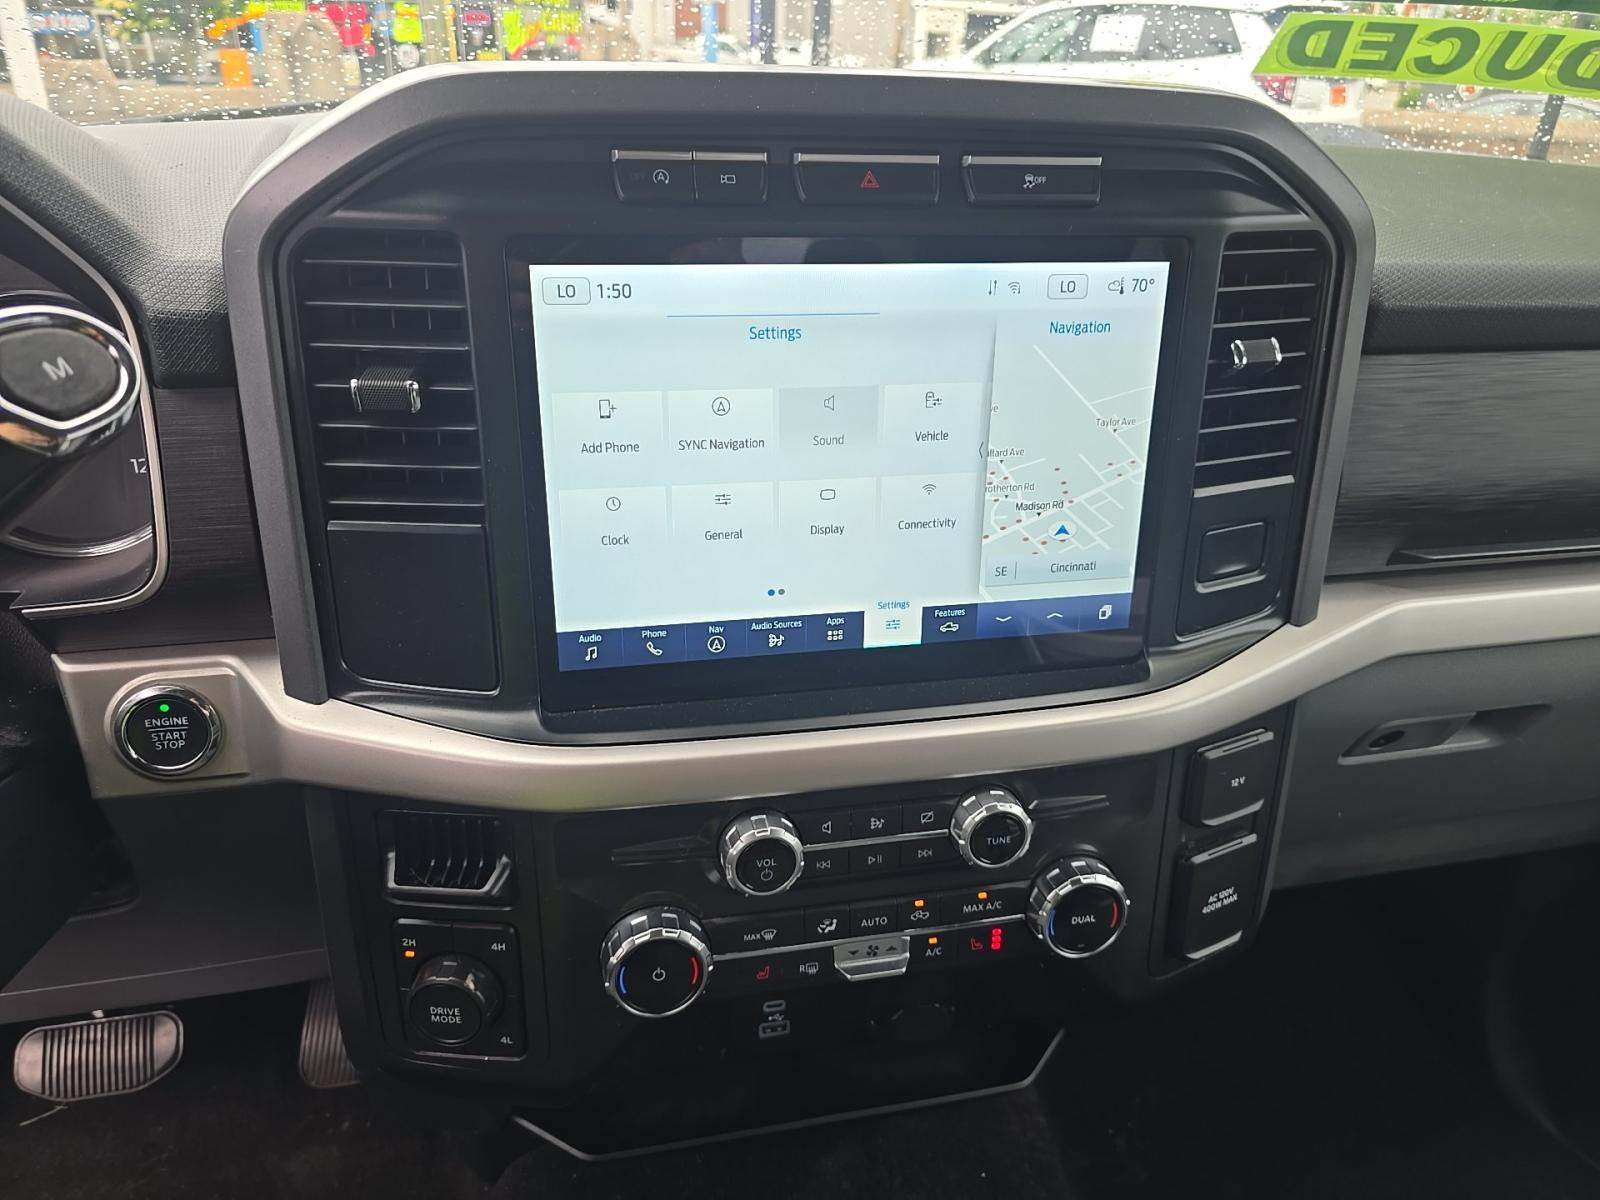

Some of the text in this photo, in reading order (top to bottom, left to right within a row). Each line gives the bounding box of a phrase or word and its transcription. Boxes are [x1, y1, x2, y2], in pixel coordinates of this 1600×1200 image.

[1034, 176, 1047, 184] OFF
[556, 283, 576, 299] LO
[595, 283, 632, 299] 1:50
[1060, 279, 1076, 294] LO
[1132, 277, 1155, 293] 70°
[749, 326, 801, 341] Settings
[1049, 320, 1111, 336] Navigation
[41, 356, 74, 381] M
[1096, 416, 1137, 429] Taylor Ave
[813, 434, 844, 447] Sound
[915, 430, 949, 443] Vehicle
[581, 441, 640, 454] Add Phone
[678, 437, 765, 451] SYNC Navigation
[1009, 447, 1025, 456] Ave
[1024, 482, 1035, 491] Rd
[1015, 500, 1064, 512] Madison Rd
[810, 523, 845, 537] Display
[898, 517, 957, 531] Connectivity
[601, 534, 629, 546] Clock
[704, 529, 743, 541] General
[995, 565, 1008, 577] SE
[1050, 560, 1097, 573] Cincinnati
[877, 599, 911, 611] Settings
[934, 608, 966, 618] Features
[751, 618, 803, 631] Audio Sources
[826, 616, 845, 628] Apps
[641, 628, 667, 639] Phone
[708, 624, 725, 634] Nav
[578, 633, 602, 644] Audio
[144, 716, 189, 727] ENGINE
[151, 731, 187, 741] START
[155, 740, 185, 750] STOP
[1231, 778, 1240, 787] 12
[986, 835, 1012, 846] TUNE
[756, 858, 777, 867] VOL
[1208, 887, 1235, 903] AC 120V
[962, 900, 1002, 913] MAX A/C
[1202, 893, 1238, 914] 400W MAX
[861, 916, 888, 927] AUTO
[1071, 914, 1095, 925] DUAL
[402, 938, 416, 947] 2H
[744, 933, 761, 942] MAX
[491, 943, 506, 951] 4H
[925, 947, 942, 957] A/C
[429, 1006, 460, 1015] DRIVE
[431, 1015, 462, 1024] MODE
[500, 1036, 513, 1044] 4L
